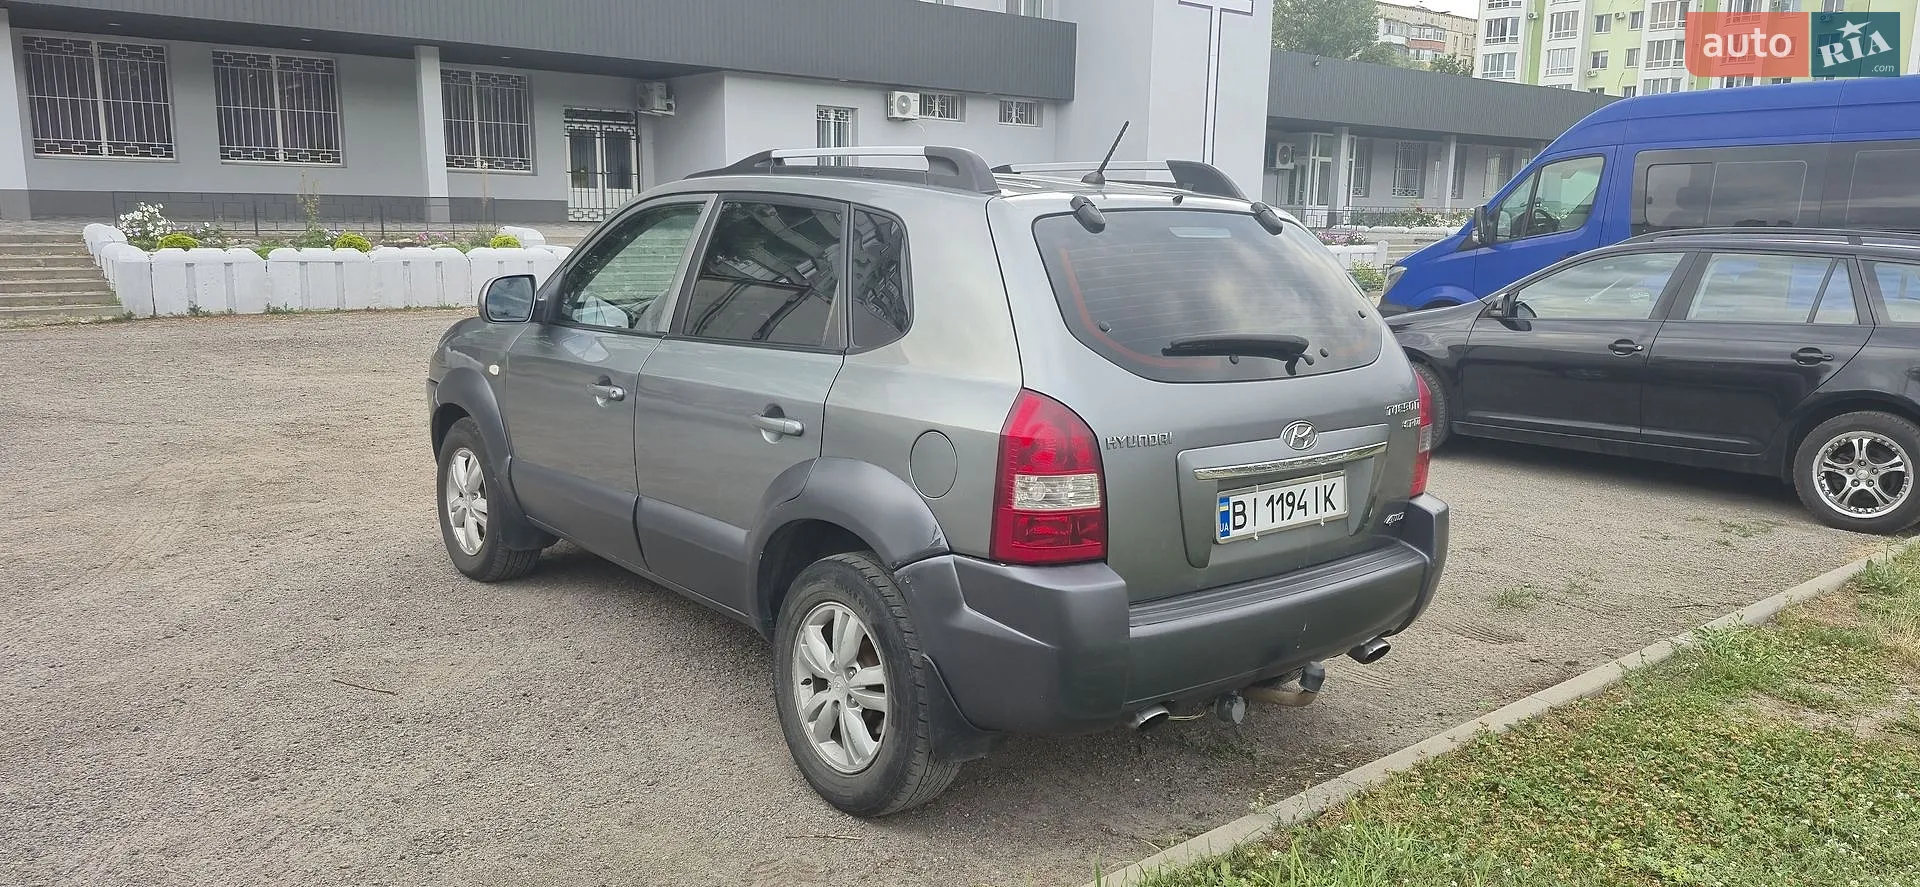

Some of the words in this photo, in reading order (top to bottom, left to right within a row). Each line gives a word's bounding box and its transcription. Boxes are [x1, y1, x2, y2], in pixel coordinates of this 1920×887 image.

[1104, 431, 1173, 450] HYUNDAI
[1232, 497, 1257, 531] BI
[1265, 488, 1308, 524] 1194
[1315, 482, 1337, 515] IK
[1219, 522, 1230, 532] UA
